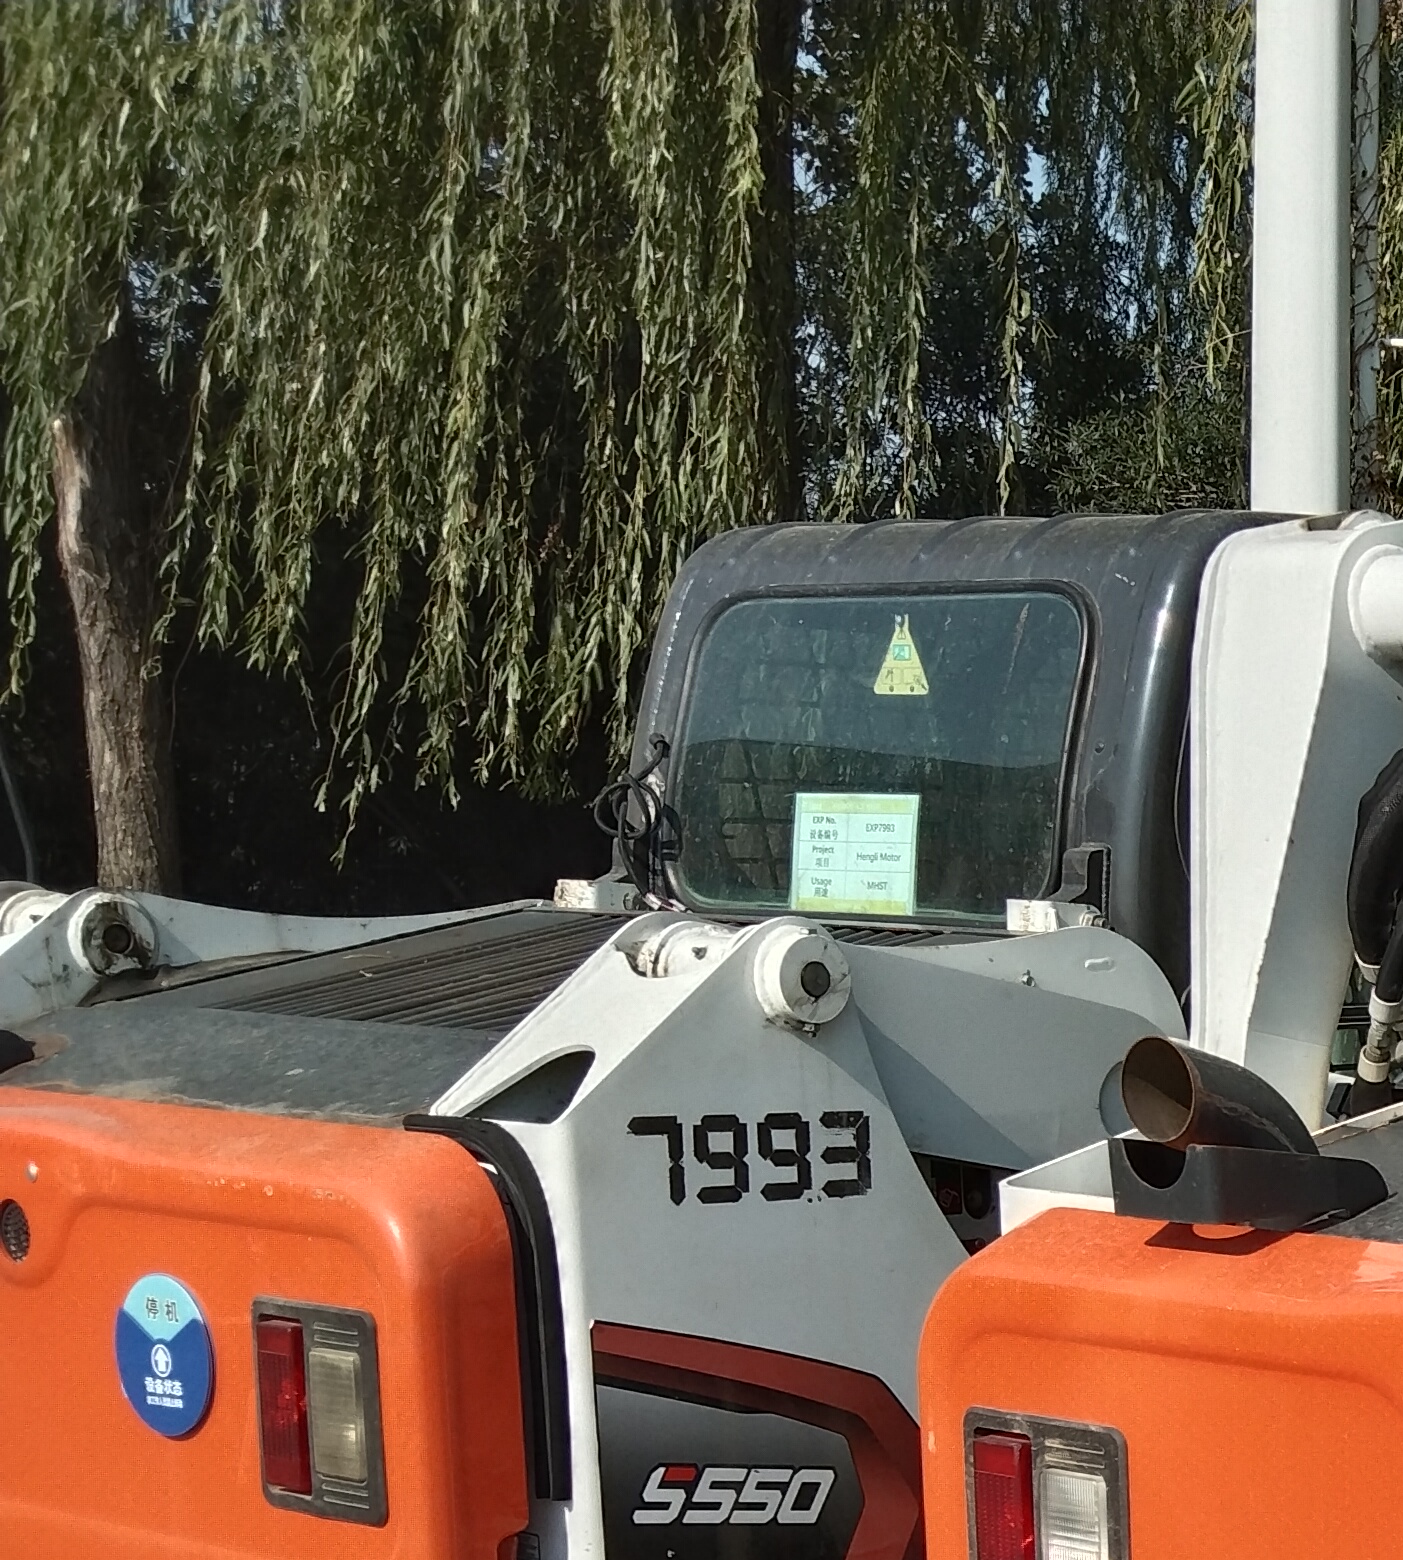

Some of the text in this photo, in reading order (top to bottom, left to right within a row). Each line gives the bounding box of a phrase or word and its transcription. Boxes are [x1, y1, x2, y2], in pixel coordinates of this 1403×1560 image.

[812, 816, 837, 825] EXP No.
[865, 823, 896, 833] EXP7993
[809, 829, 839, 840] 设备编号
[812, 845, 835, 855] Project
[856, 852, 901, 863] Hengli Motor
[815, 858, 830, 868] 项目
[811, 877, 832, 887] Usage
[867, 881, 888, 890] MHST
[813, 887, 829, 897] 用途
[627, 1111, 872, 1206] 7993
[144, 1376, 184, 1396] 设备状态
[632, 1466, 836, 1524] S550
